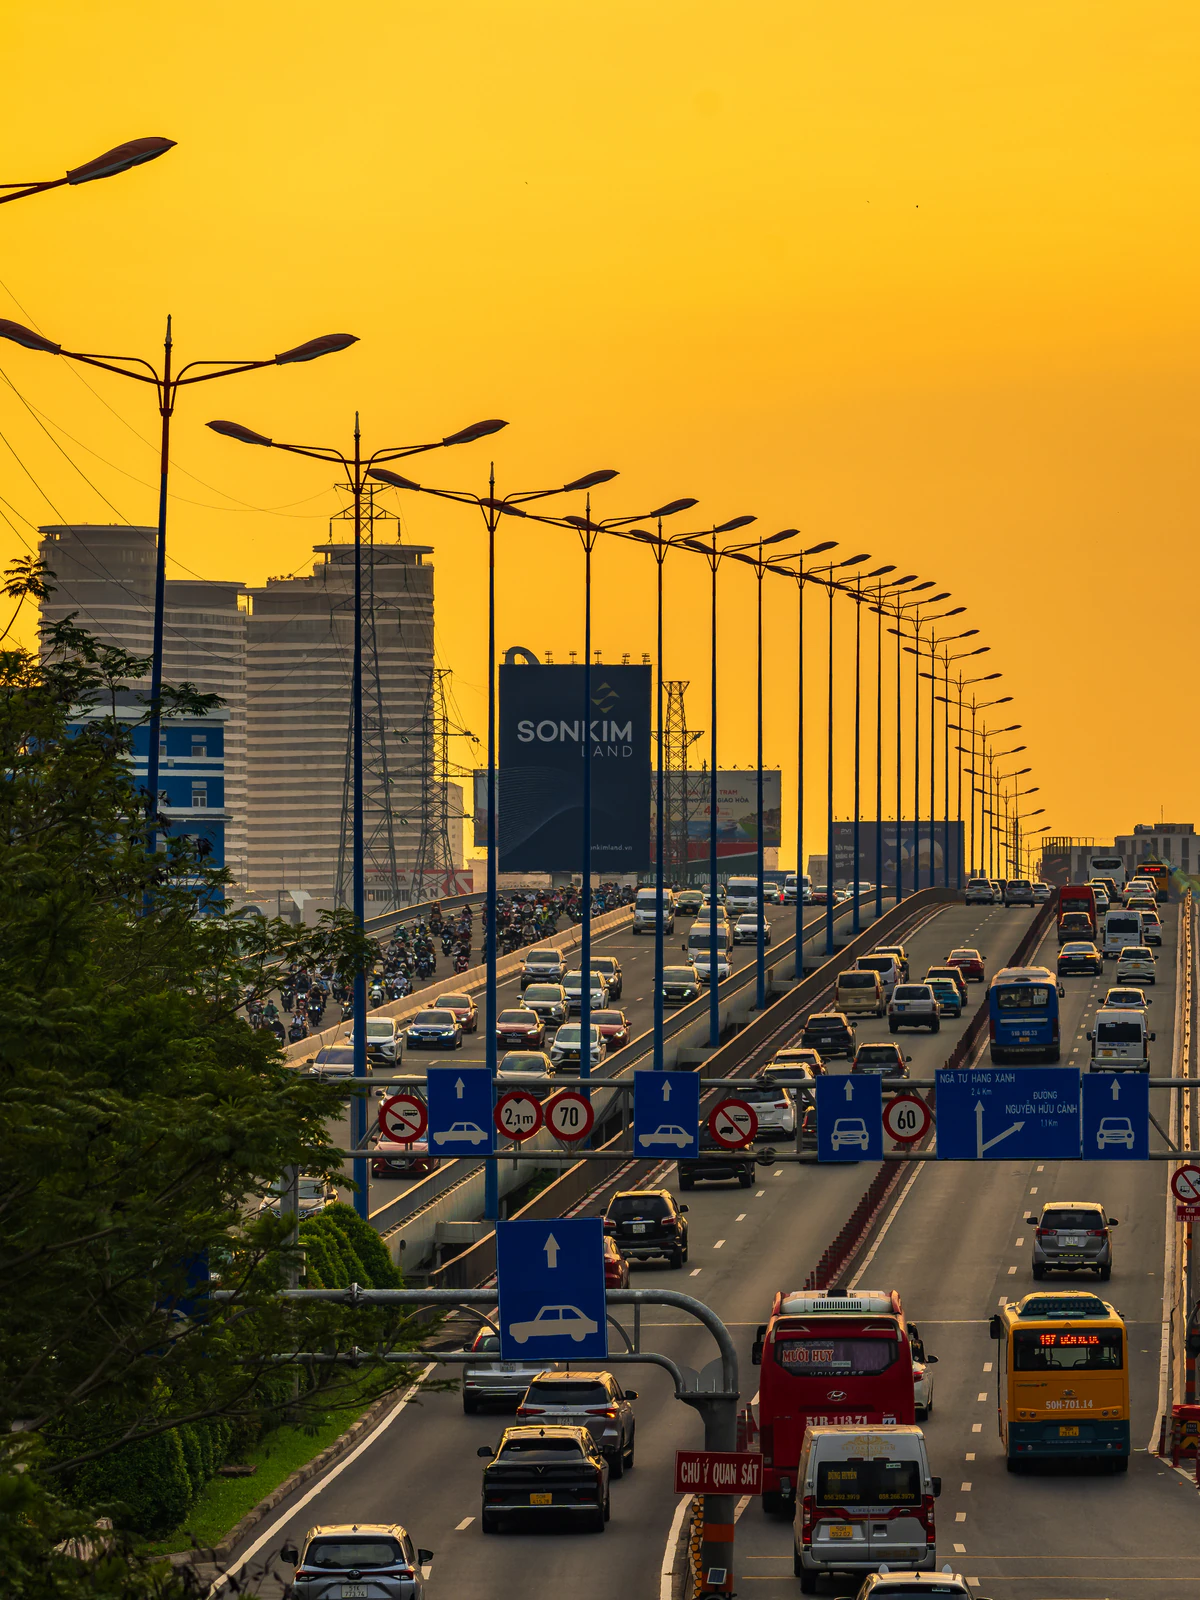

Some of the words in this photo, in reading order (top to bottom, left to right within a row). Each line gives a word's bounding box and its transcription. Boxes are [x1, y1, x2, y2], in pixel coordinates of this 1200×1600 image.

[517, 720, 632, 742] SONKIM
[581, 745, 632, 757] LAND
[939, 1071, 955, 1083] NGÃ
[958, 1073, 968, 1082] TƯ
[971, 1070, 992, 1082] HÀNG
[995, 1073, 1016, 1082] XANH
[1033, 1088, 1058, 1100] ĐƯỜNG
[1005, 1100, 1036, 1114] NGUYỄN
[1038, 1101, 1054, 1114] HỮU
[1056, 1100, 1078, 1114] CẢNH
[560, 1107, 579, 1127] 70
[897, 1109, 916, 1130] 60
[812, 1349, 834, 1363] HUY
[1045, 1400, 1093, 1410] 50H-701.14
[681, 1458, 700, 1484] CHÚ
[702, 1458, 709, 1484] Ý
[712, 1462, 737, 1488] QUAN
[741, 1459, 759, 1485] SÁT
